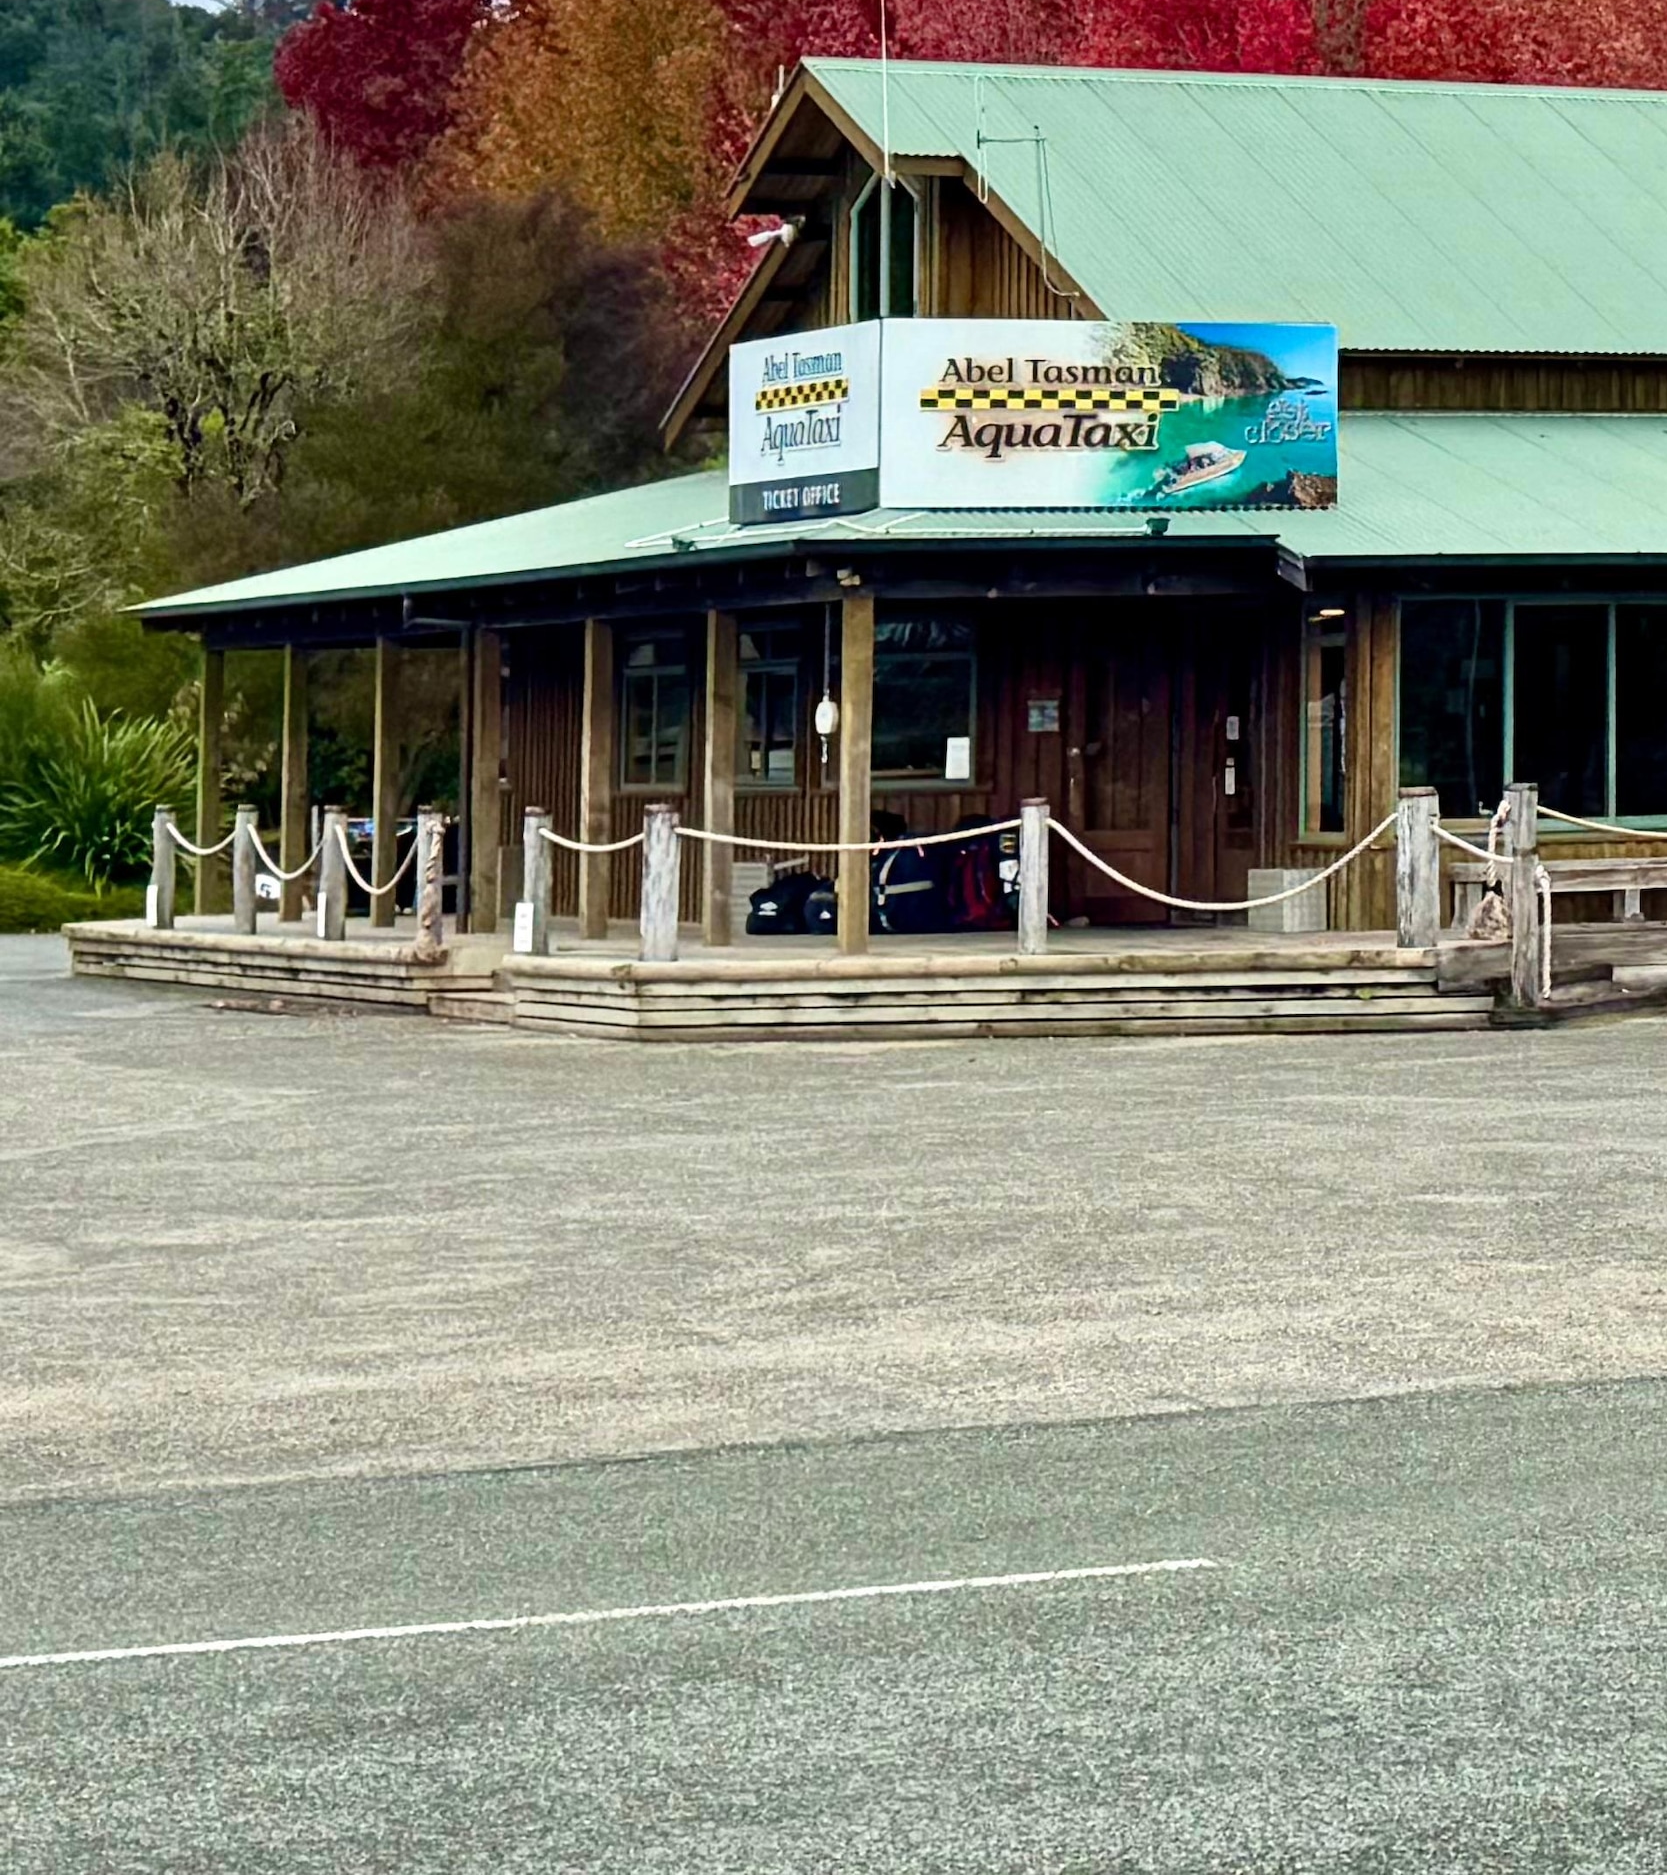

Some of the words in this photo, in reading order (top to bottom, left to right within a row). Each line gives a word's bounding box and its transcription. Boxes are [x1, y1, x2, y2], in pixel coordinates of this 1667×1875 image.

[762, 353, 789, 383] Abel
[791, 352, 842, 378] Tasman
[939, 357, 1014, 384] Abel
[1025, 358, 1160, 385] Tasman
[761, 404, 842, 461] AquaTaxi
[938, 412, 1159, 458] AquaTaxi
[762, 487, 800, 511] TICKET
[802, 483, 841, 506] OFFICE
